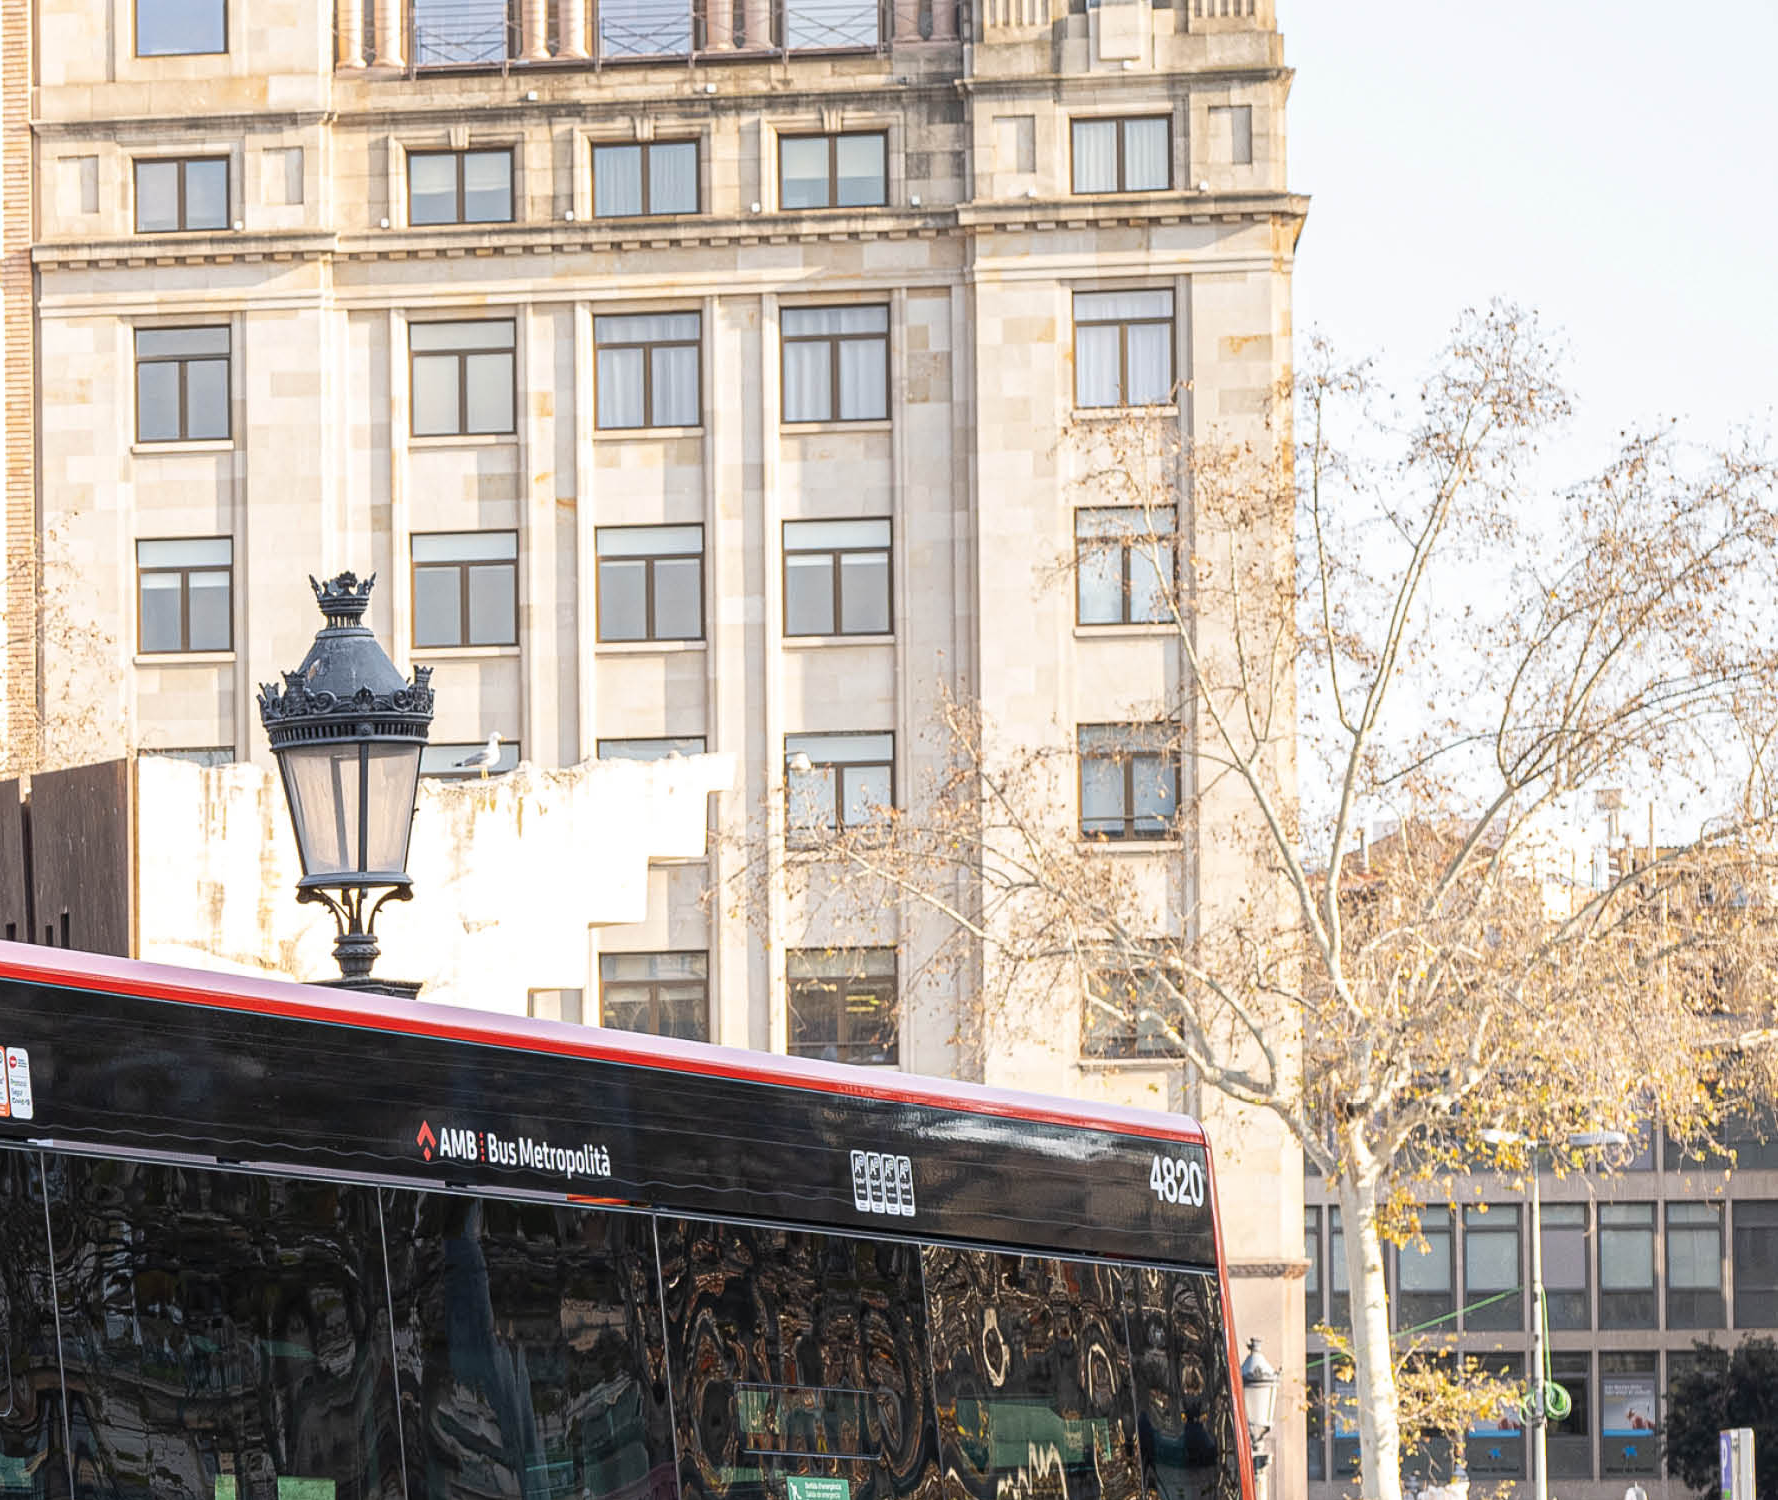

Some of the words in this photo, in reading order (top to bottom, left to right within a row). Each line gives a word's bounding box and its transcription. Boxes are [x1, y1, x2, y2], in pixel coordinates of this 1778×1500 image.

[440, 1127, 478, 1160] AMB
[487, 1133, 517, 1166] Bus
[518, 1137, 612, 1179] Metropolità
[1150, 1155, 1204, 1208] 4820
